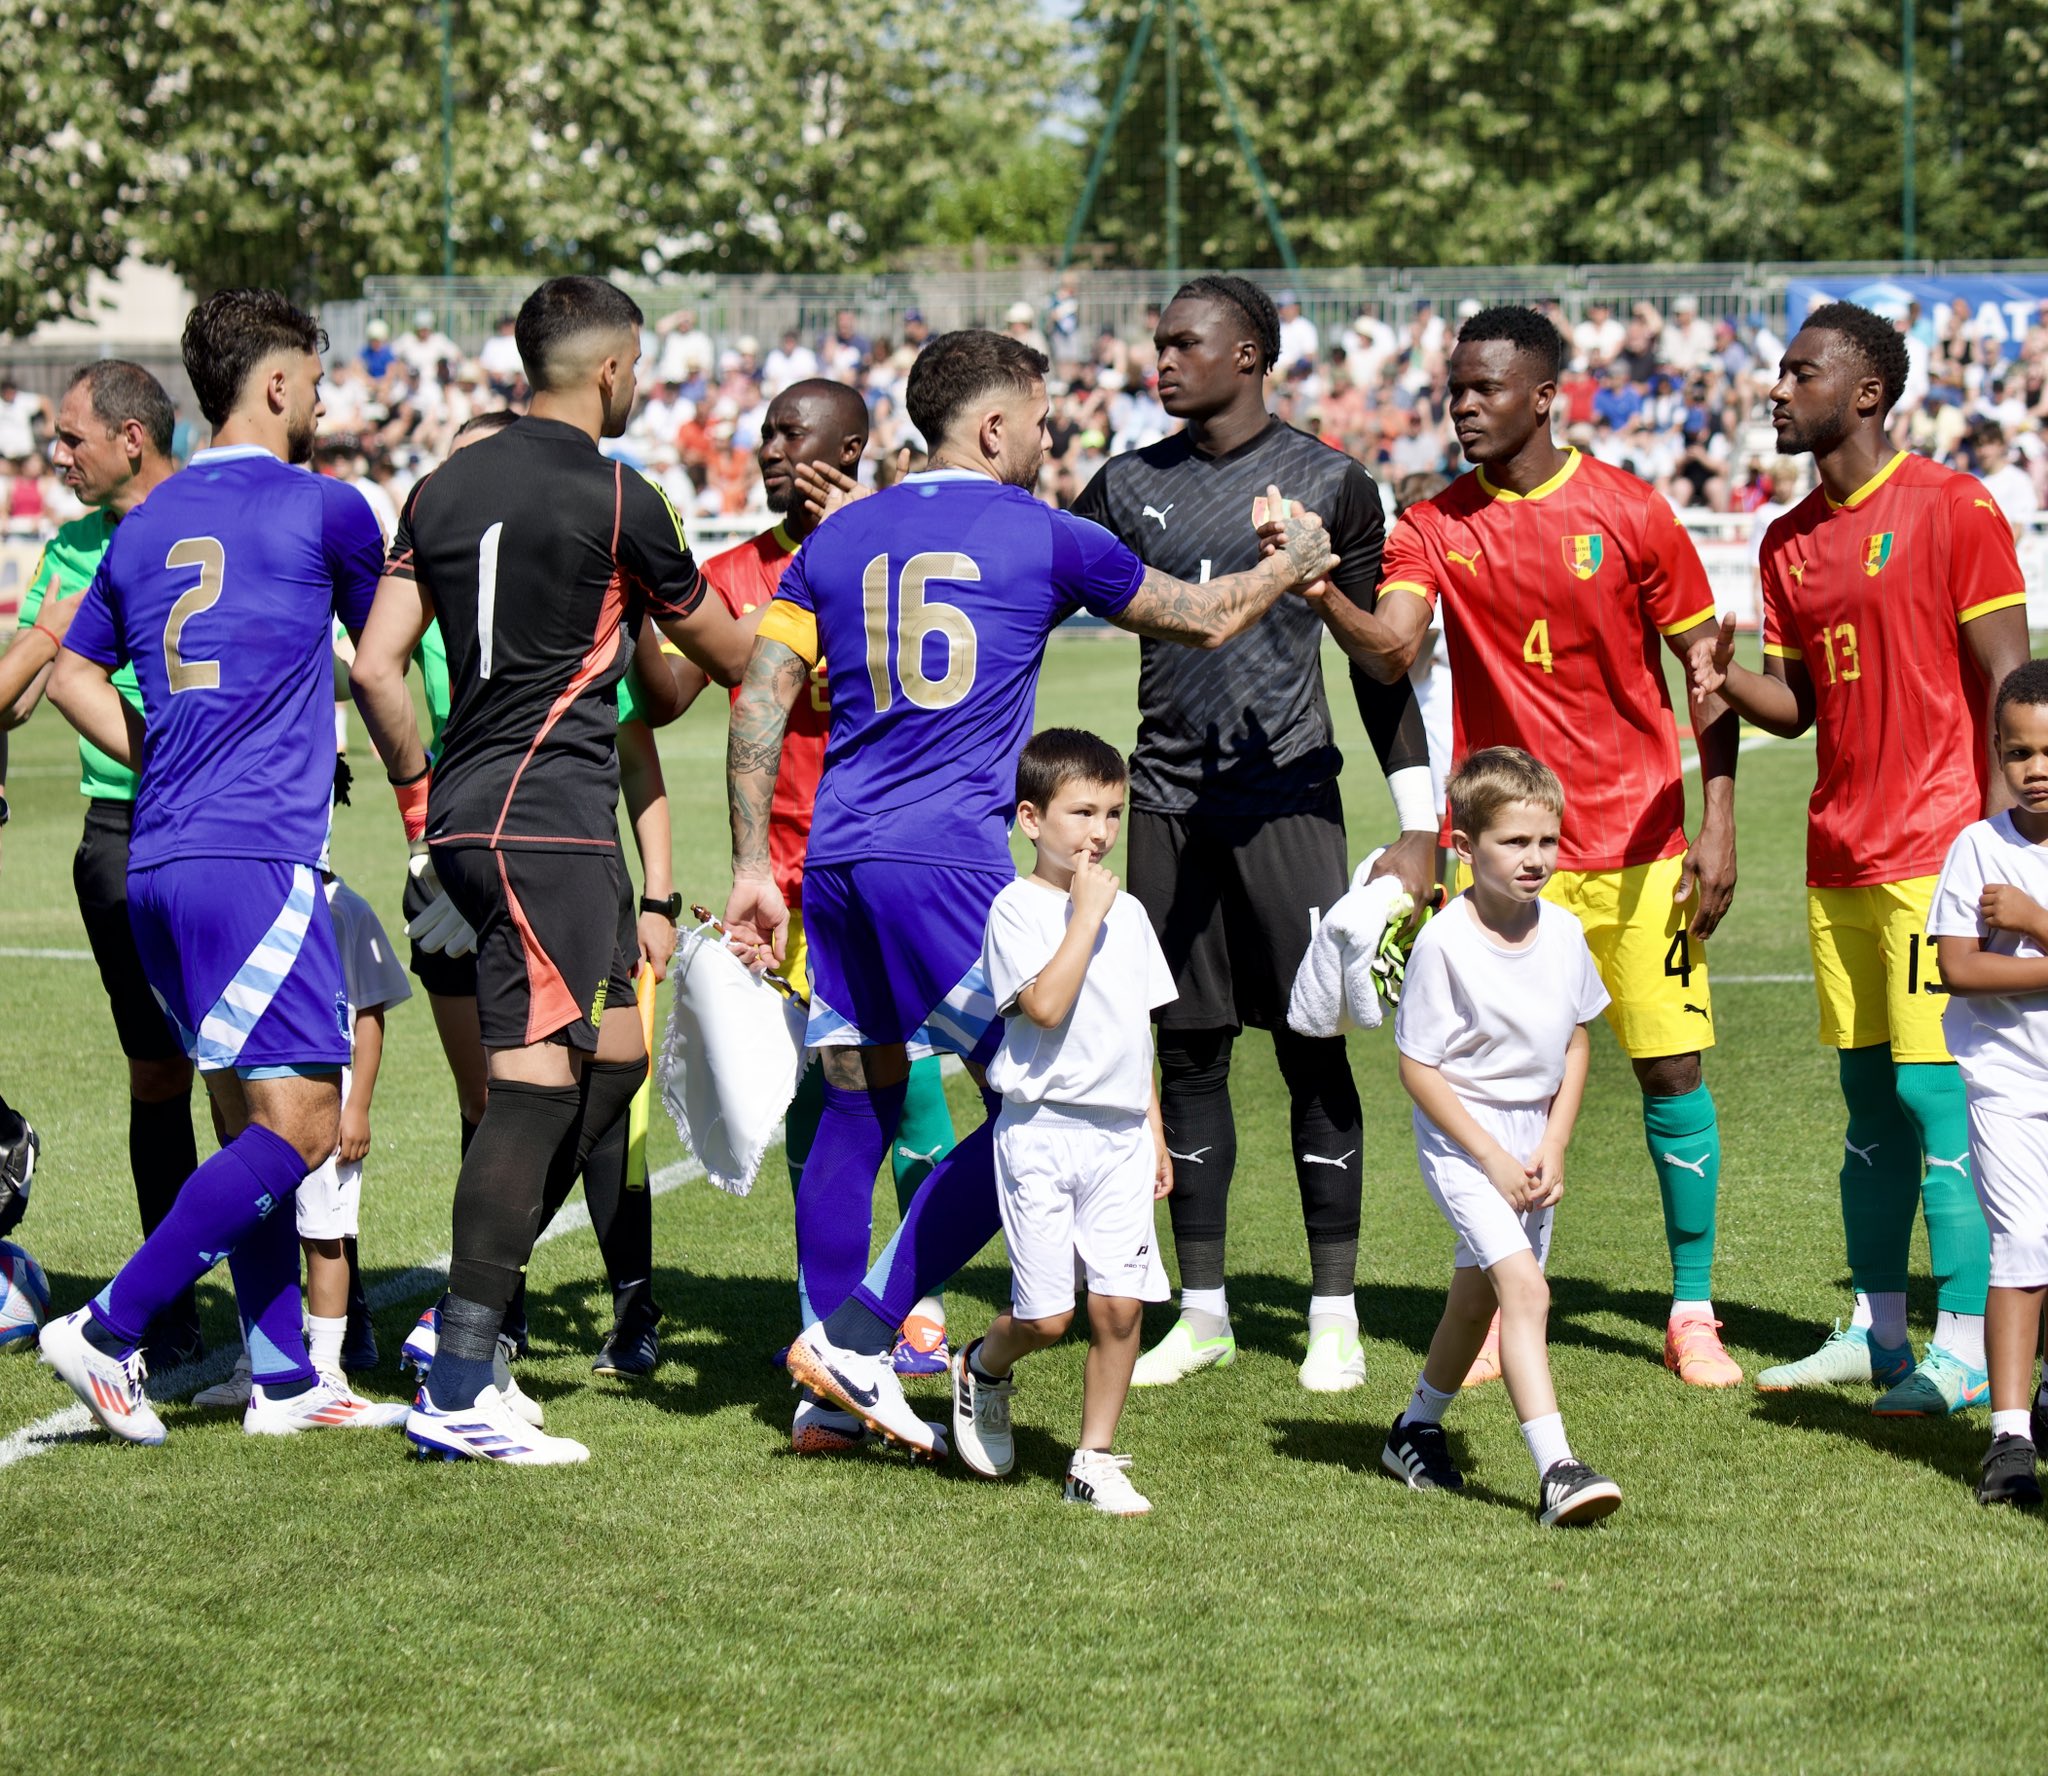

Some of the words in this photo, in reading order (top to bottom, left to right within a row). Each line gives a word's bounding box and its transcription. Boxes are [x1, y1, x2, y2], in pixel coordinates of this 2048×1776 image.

[164, 536, 225, 695] 2
[478, 521, 503, 680] 1
[862, 551, 981, 714] 16
[1523, 619, 1553, 674] 4
[1823, 623, 1861, 684] 13
[1664, 929, 1691, 988] 4
